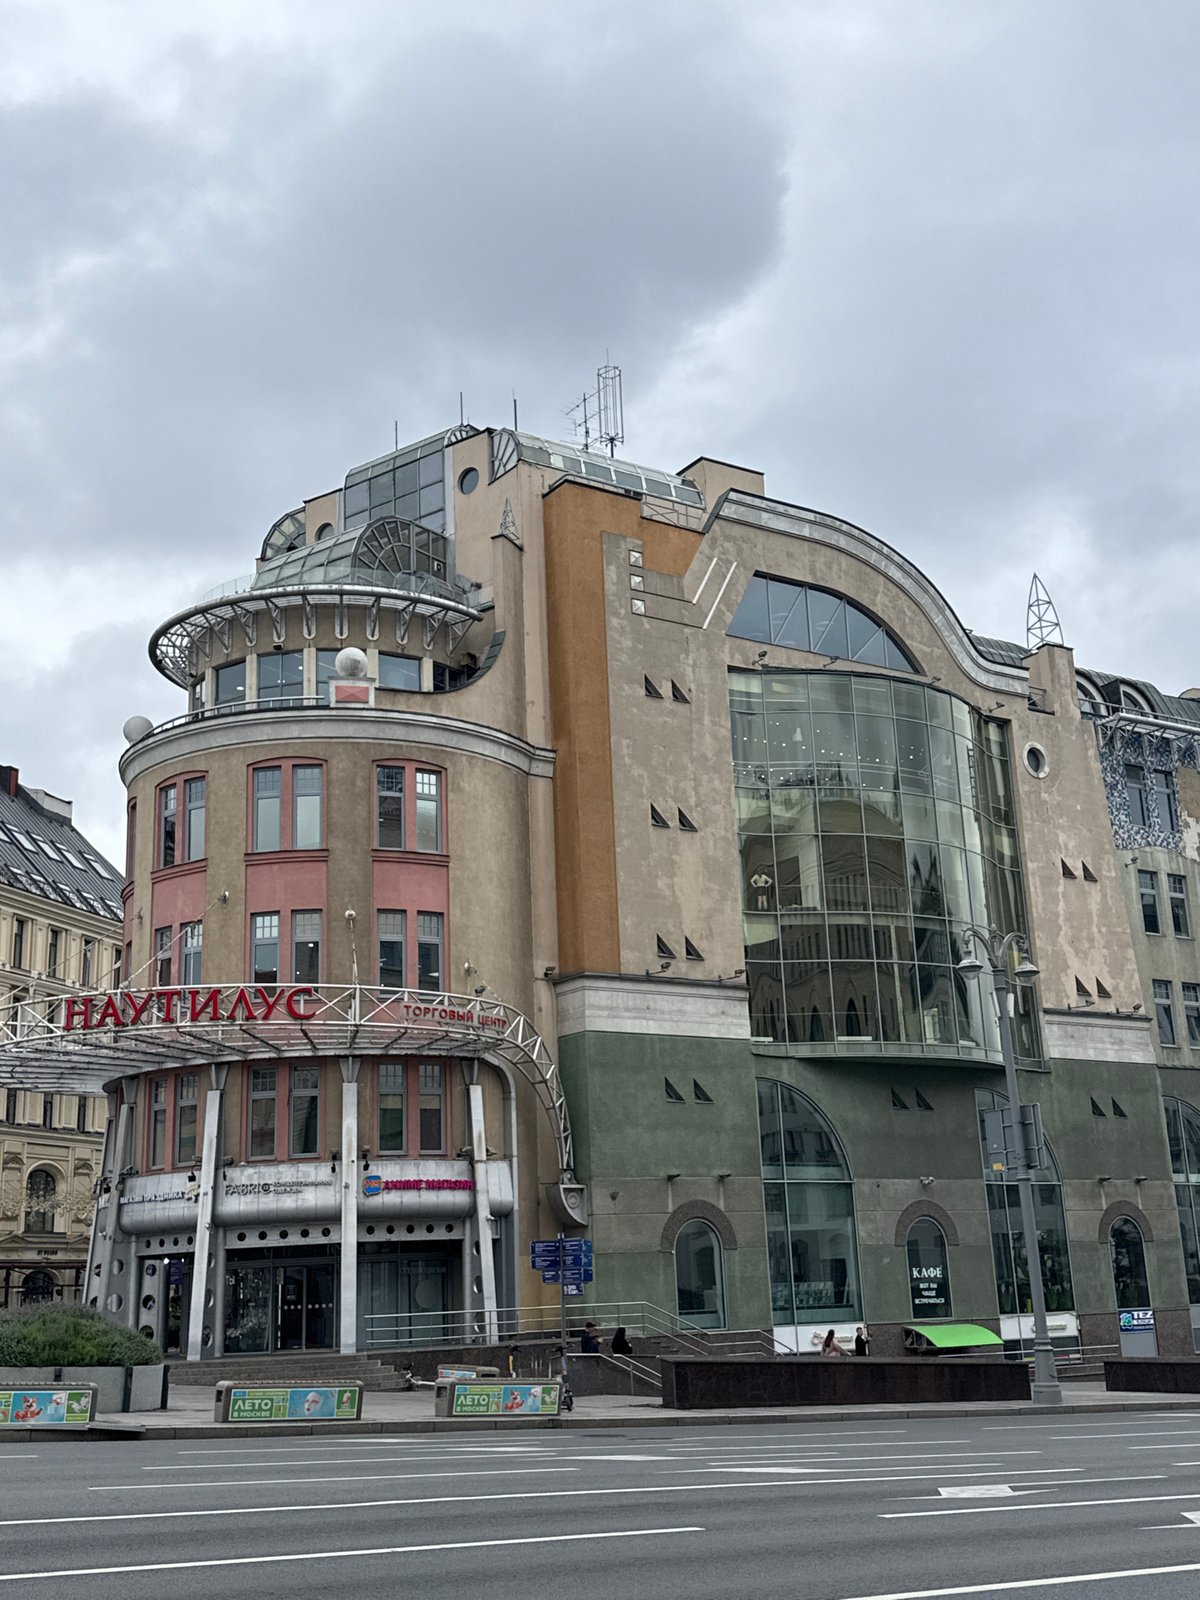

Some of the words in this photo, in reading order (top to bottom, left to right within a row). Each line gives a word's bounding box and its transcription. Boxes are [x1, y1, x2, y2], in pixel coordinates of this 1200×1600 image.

[63, 987, 317, 1031] НАУТИЛУС
[403, 1004, 474, 1023] ТОРГОВЫЙ
[477, 1014, 507, 1029] ЦЕНТР
[912, 1267, 943, 1278] КАФЕ
[1132, 1310, 1153, 1319] TEZ
[234, 1399, 272, 1411] ЛЕТО
[457, 1394, 489, 1406] ЛЕТО
[240, 1410, 271, 1418] МОСКВЕ
